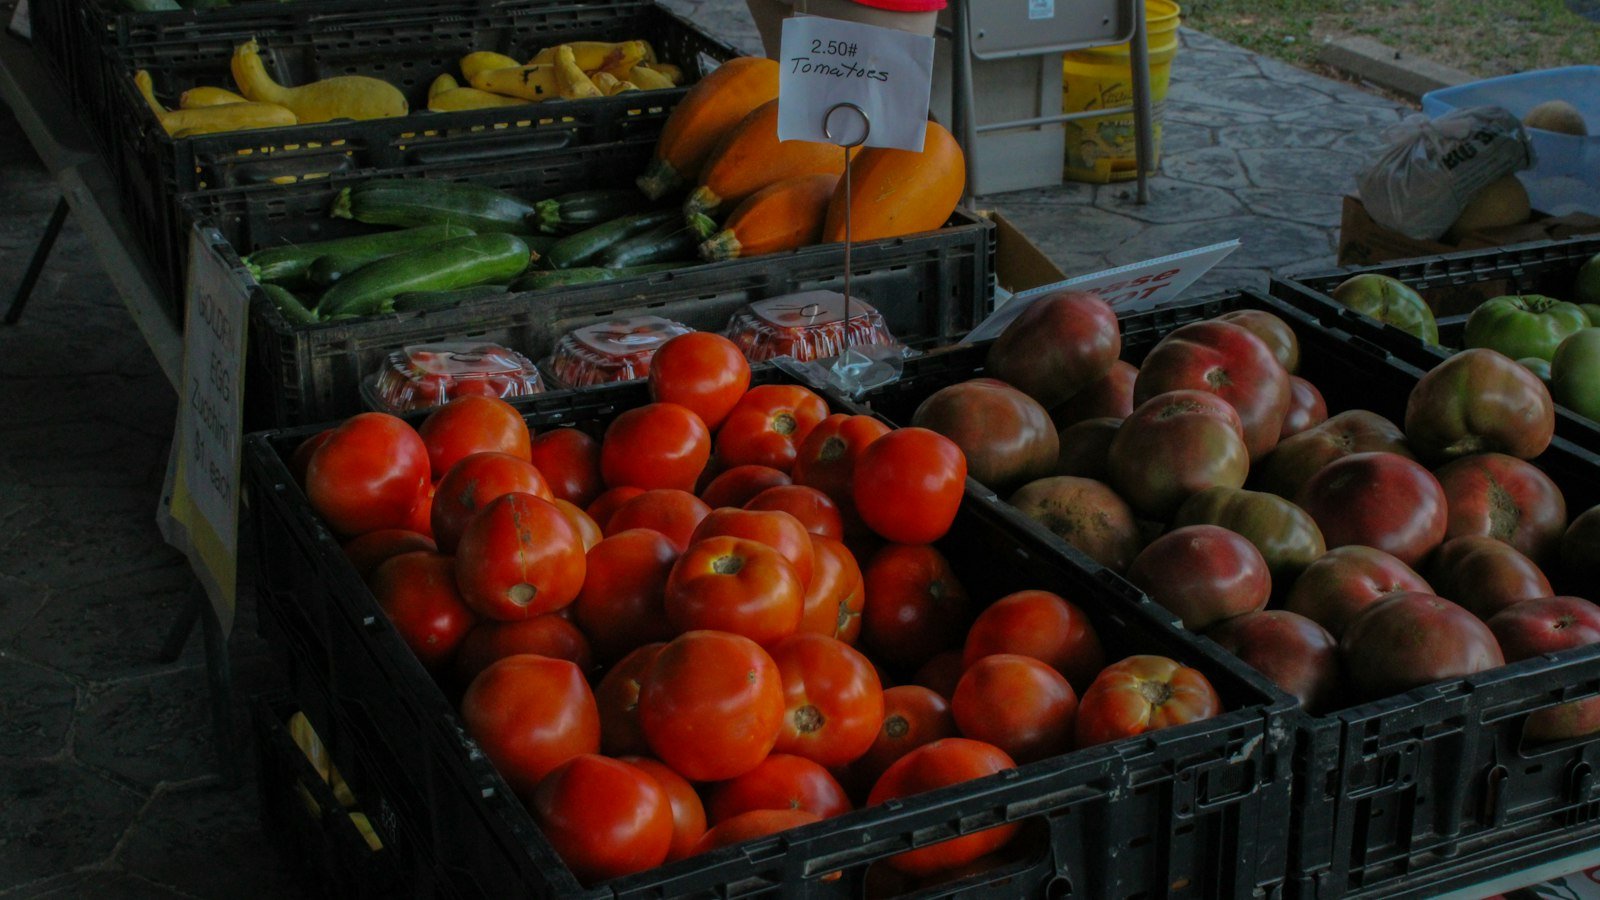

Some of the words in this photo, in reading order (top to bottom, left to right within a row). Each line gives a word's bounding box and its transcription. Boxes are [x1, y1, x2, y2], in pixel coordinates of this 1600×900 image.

[811, 39, 858, 57] 2.50#
[791, 57, 889, 81] Tomatoes
[210, 351, 230, 403] EGG
[209, 460, 231, 509] each
